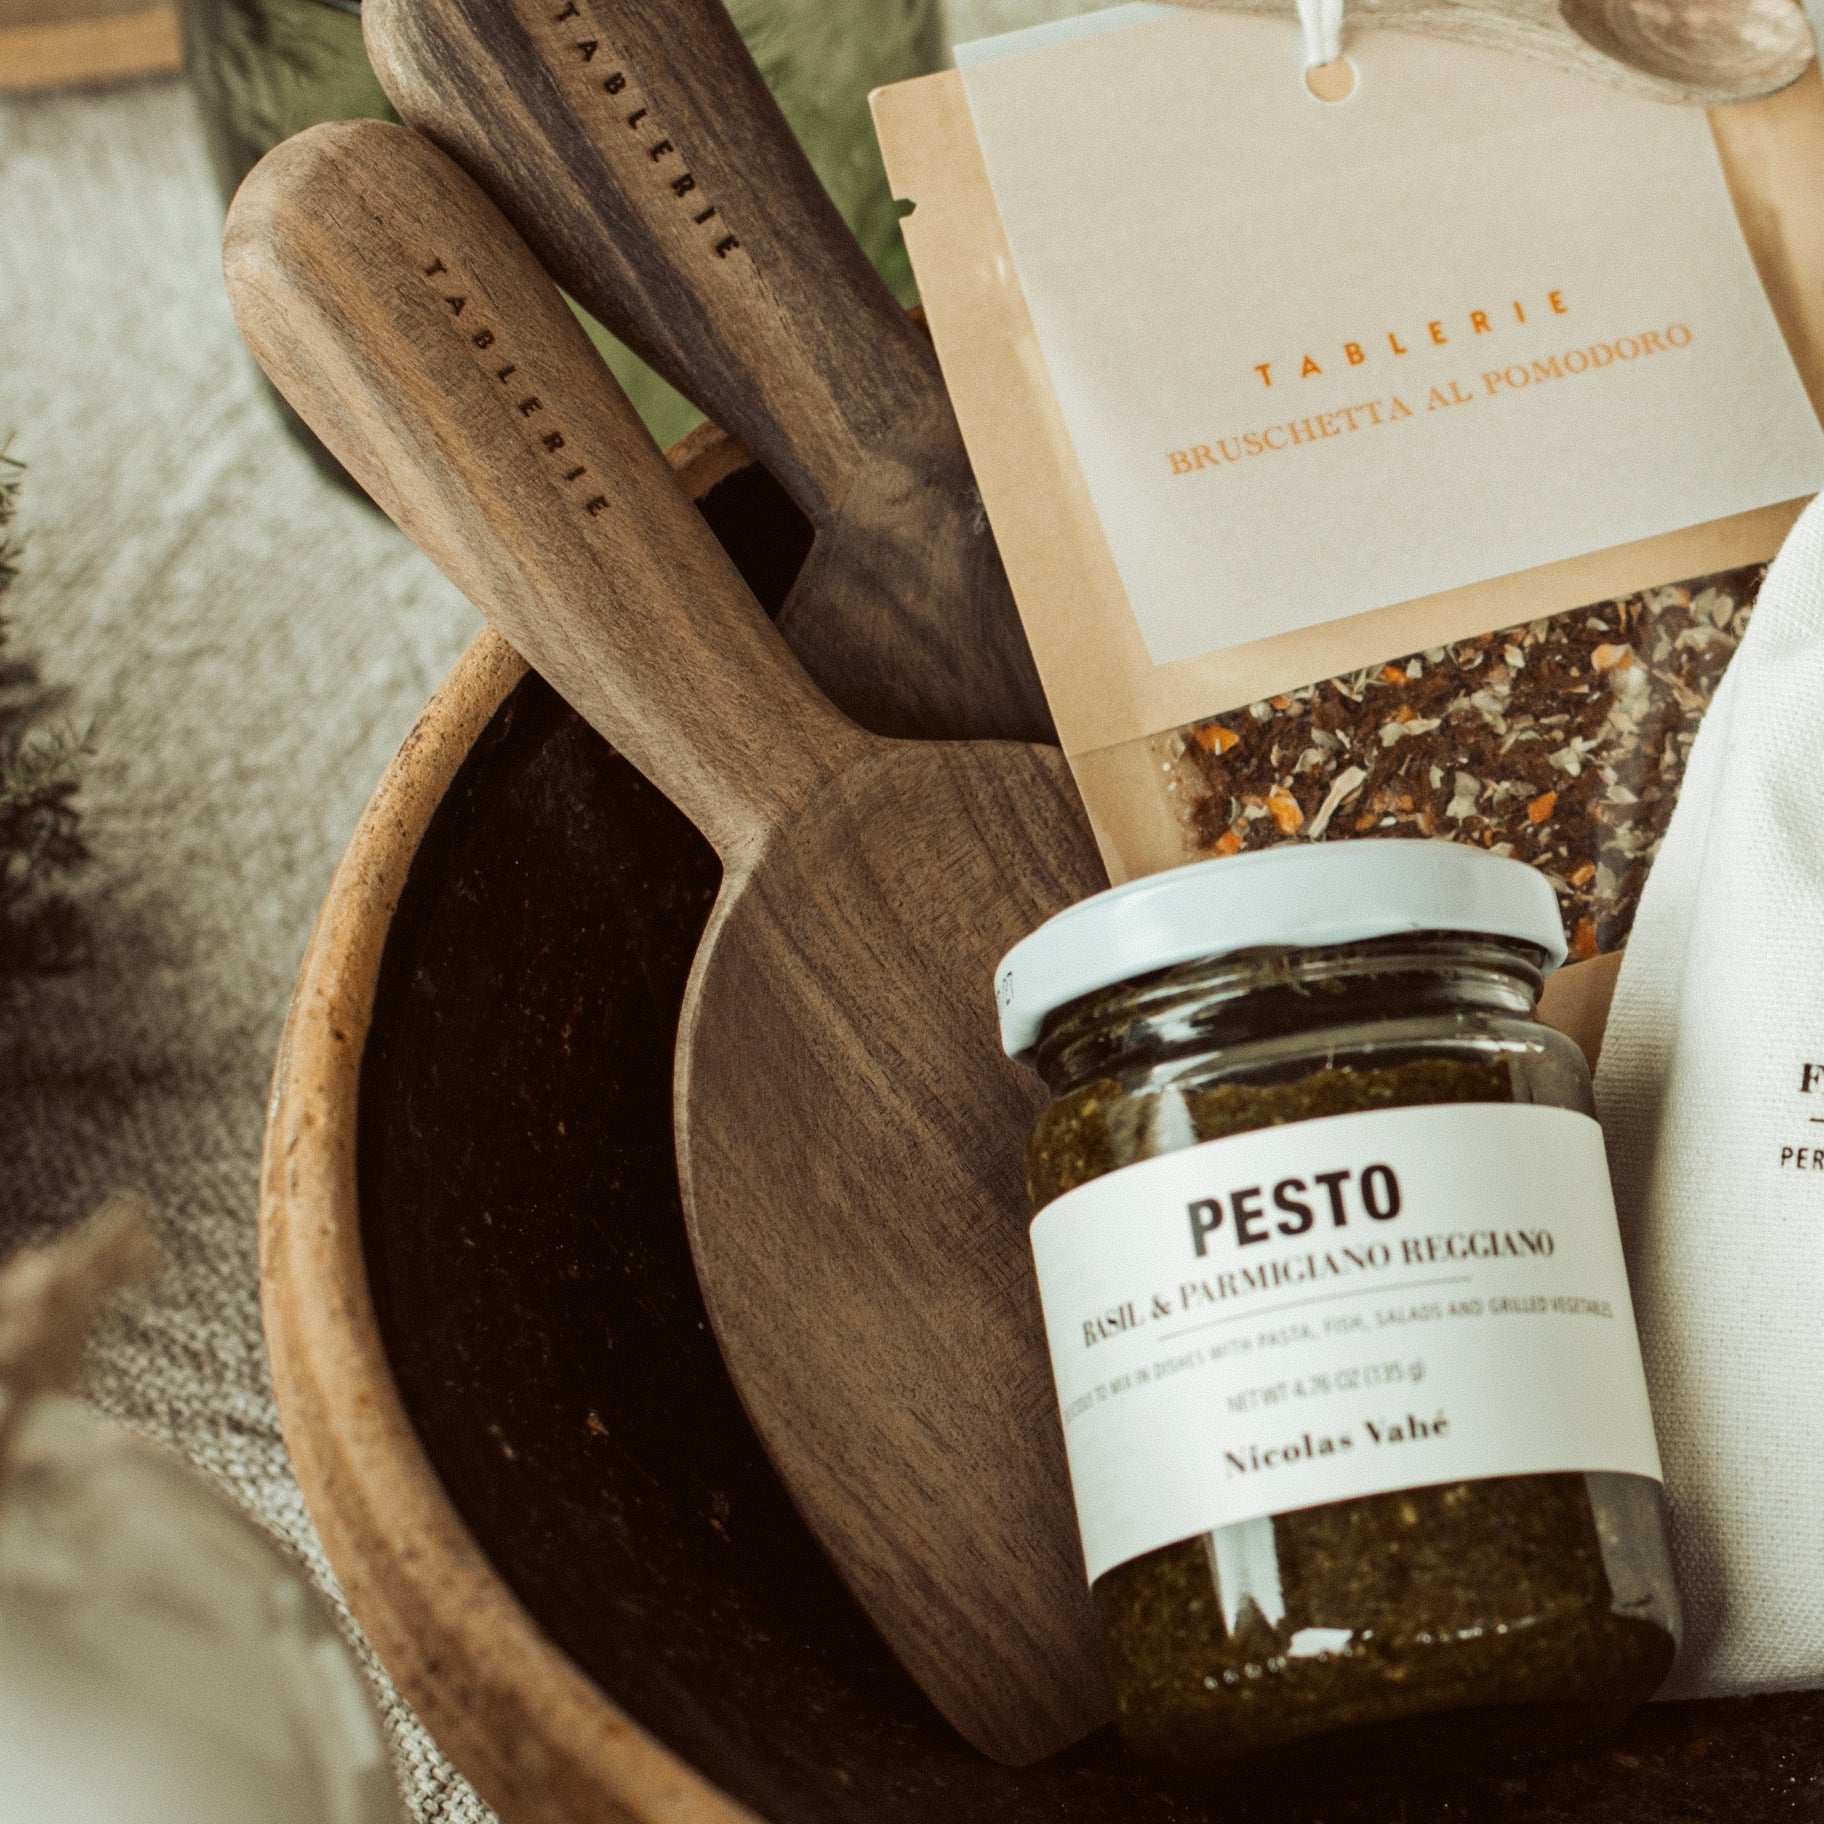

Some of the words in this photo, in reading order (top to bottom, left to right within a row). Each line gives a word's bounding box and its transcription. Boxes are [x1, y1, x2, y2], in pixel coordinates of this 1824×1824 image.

[556, 0, 740, 259] TABLERIE
[424, 257, 610, 518] TABLERIE
[1254, 288, 1568, 387] TABLERIE
[1165, 396, 1414, 475] BRUSCHETTA
[1426, 380, 1473, 412] AL
[1481, 323, 1694, 396] POMODORO
[1187, 1163, 1401, 1258] PESTO
[1081, 1300, 1146, 1347] BASIL
[1151, 1293, 1171, 1320] &
[1179, 1243, 1391, 1310] PARMIGIANO
[1401, 1228, 1556, 1266] REGGIANO
[1223, 1432, 1355, 1477] Nicolas
[1364, 1407, 1448, 1444] Vahé
